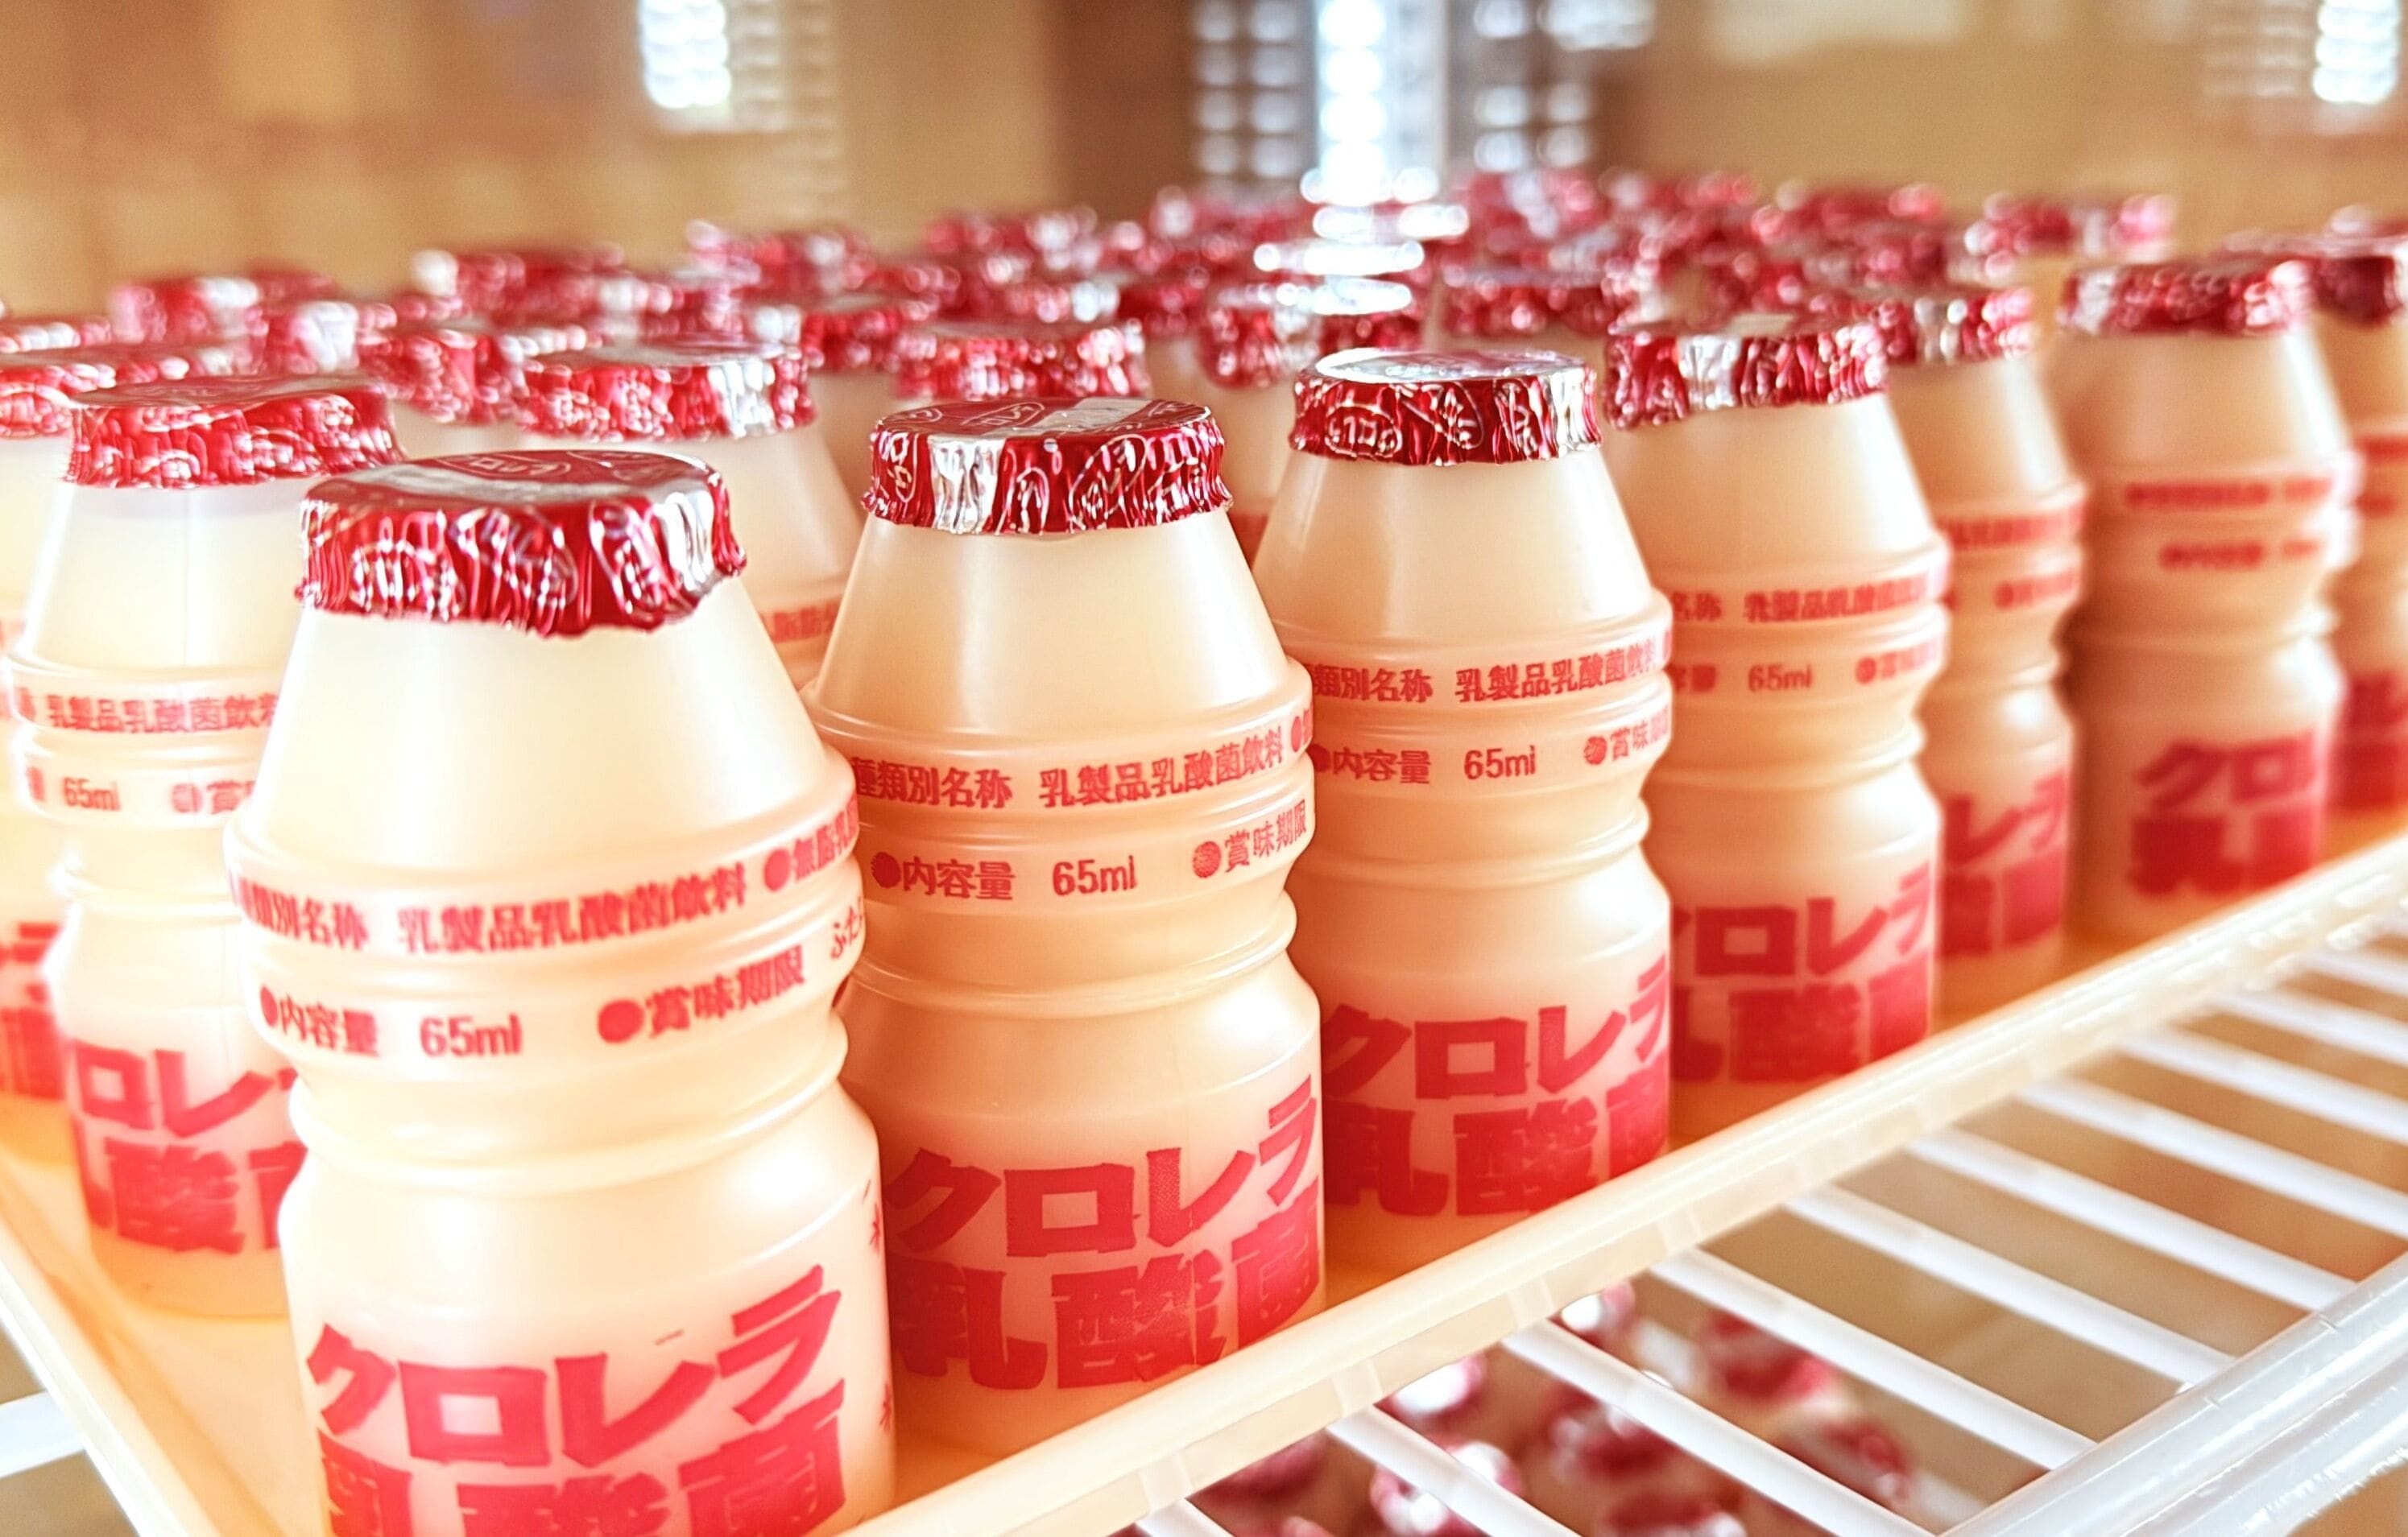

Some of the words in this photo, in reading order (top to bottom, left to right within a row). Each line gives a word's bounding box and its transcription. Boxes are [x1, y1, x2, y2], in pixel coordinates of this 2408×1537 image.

[1302, 663, 1434, 704] 類別名称
[1748, 664, 1812, 693] 65ml
[61, 776, 122, 812] 65ml
[1038, 725, 1284, 809] 乳製品乳酸菌飲料
[1332, 747, 1432, 784] 内容量
[1463, 746, 1536, 780] 65ml
[902, 855, 1015, 901] 内容量
[1052, 855, 1138, 897] 65ml
[1224, 798, 1307, 874] 賞味期限
[1670, 858, 1931, 977] ロレラ
[278, 992, 382, 1059] 内容量
[420, 1011, 523, 1058] 65ml
[647, 944, 804, 1039] 賞味期限
[1322, 952, 1666, 1100] クロレラ
[73, 1039, 299, 1138] ロレ
[886, 1072, 1318, 1258] クロレラ
[306, 1263, 842, 1467] クロレラ
